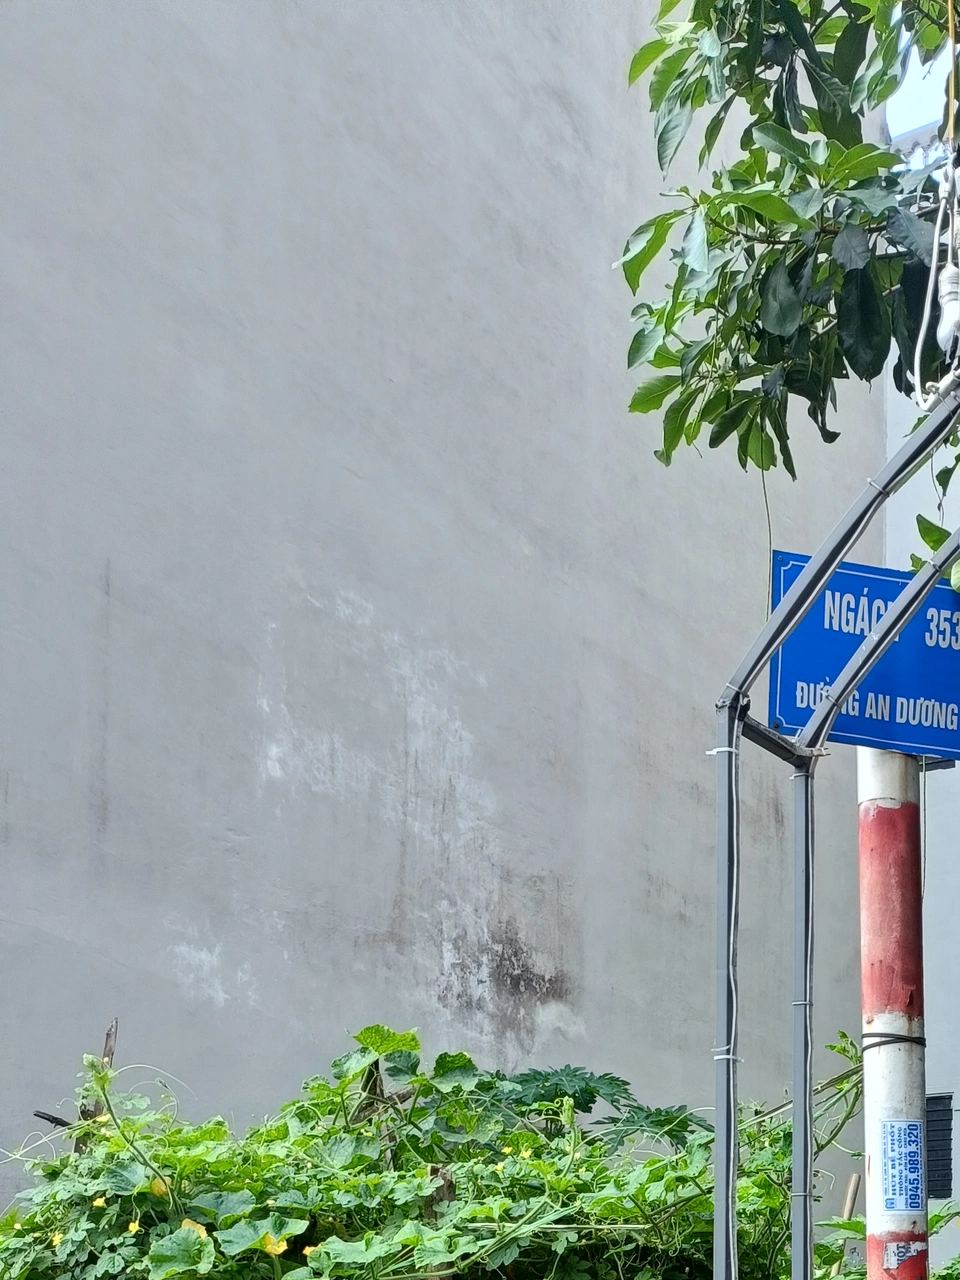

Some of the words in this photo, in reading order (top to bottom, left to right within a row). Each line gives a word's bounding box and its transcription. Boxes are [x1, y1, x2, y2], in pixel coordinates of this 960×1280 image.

[823, 588, 900, 642] NGÁC
[865, 692, 890, 722] AN
[896, 697, 958, 731] DƯƠNG
[907, 1123, 920, 1209] 0945.989.320
